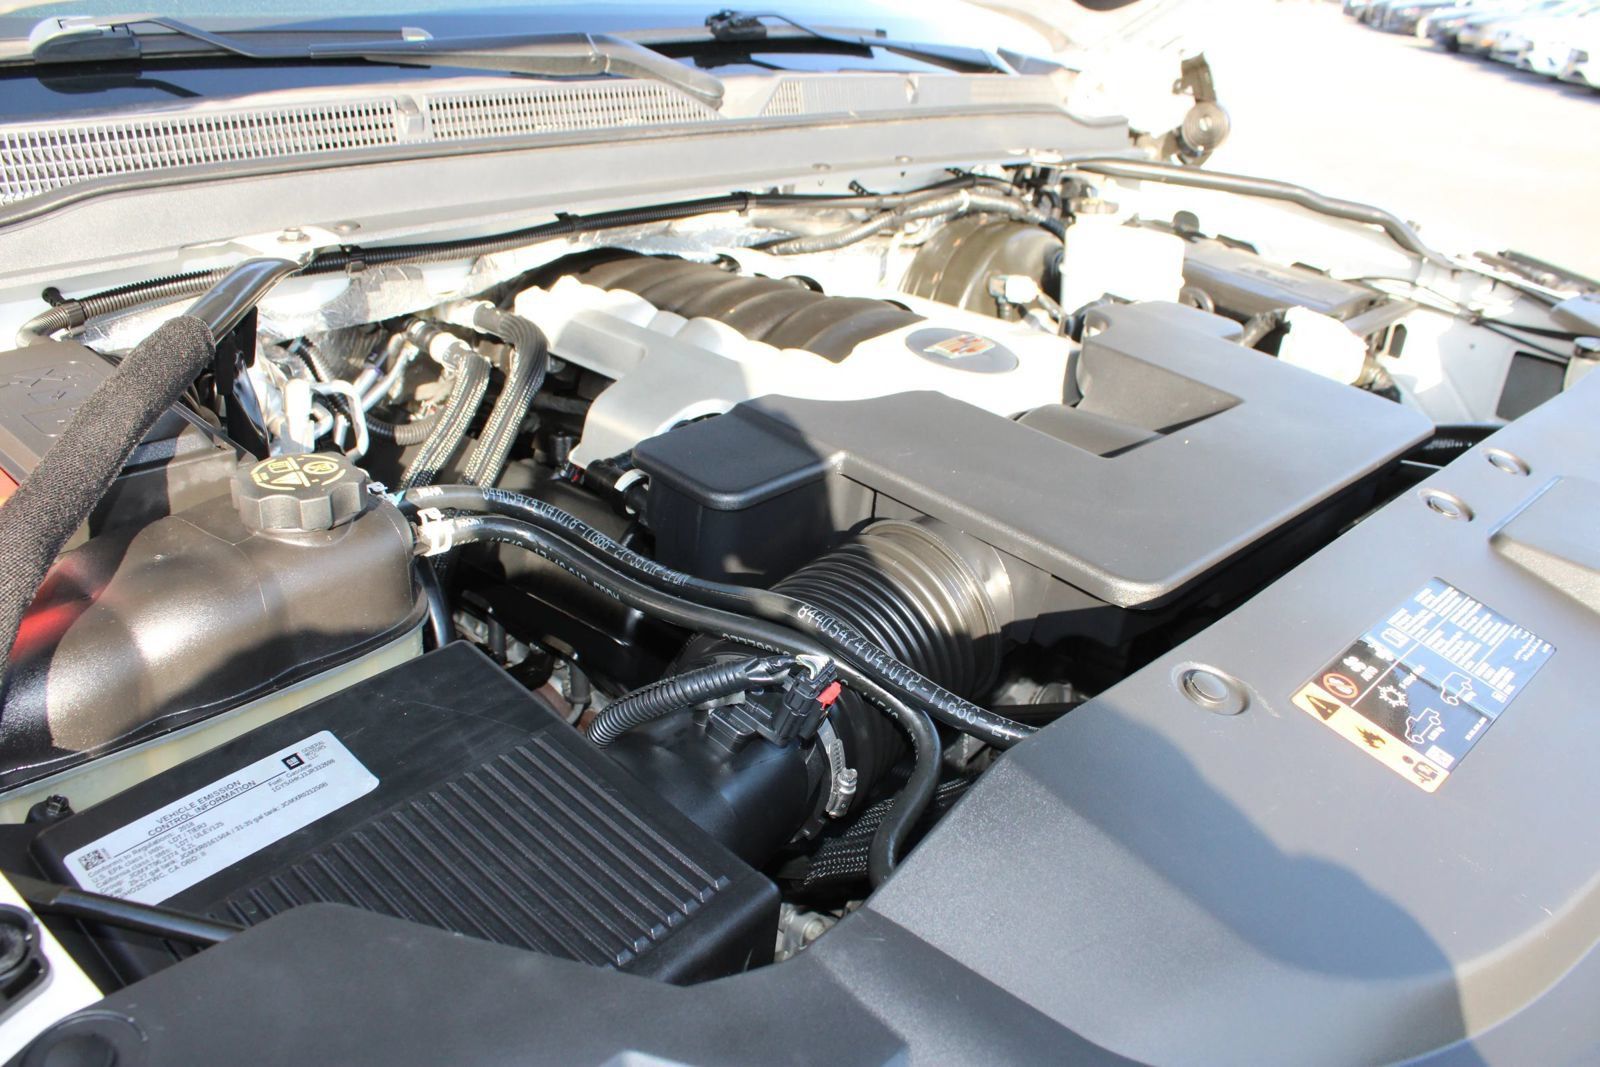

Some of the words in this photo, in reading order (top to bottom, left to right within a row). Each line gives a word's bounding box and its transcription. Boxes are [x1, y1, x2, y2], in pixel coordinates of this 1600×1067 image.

[147, 812, 192, 837] CONTROL
[194, 780, 256, 814] INFORMATION
[157, 803, 196, 824] VEHICLE
[198, 780, 241, 804] EMISSION
[175, 839, 189, 848] LDT
[178, 822, 194, 832] 2018
[108, 865, 123, 875] EPA
[169, 835, 182, 844] LDT
